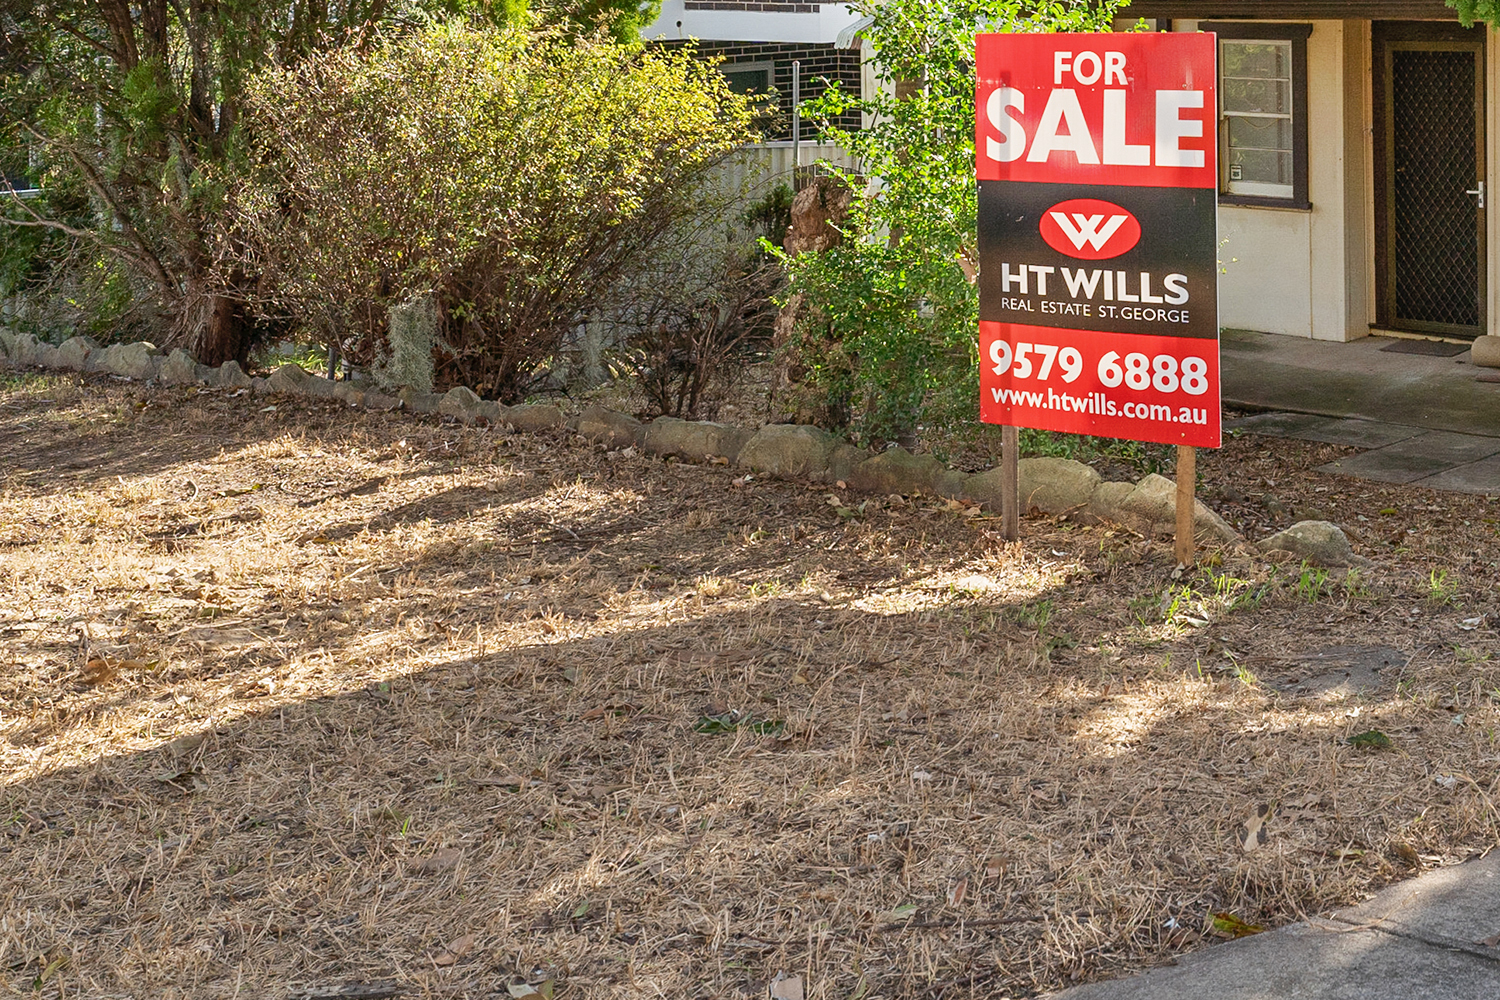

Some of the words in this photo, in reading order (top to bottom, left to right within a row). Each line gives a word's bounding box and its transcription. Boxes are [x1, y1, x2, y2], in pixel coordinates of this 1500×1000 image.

[1053, 51, 1129, 86] FOR
[986, 87, 1206, 168] SALE
[1001, 262, 1055, 296] HT
[1060, 267, 1190, 305] WILLS
[1001, 297, 1035, 312] REAL
[1041, 300, 1091, 317] ESTATE
[989, 339, 1083, 384] 9579
[1097, 350, 1209, 395] 6888
[991, 386, 1208, 426] www.htwills.com.au
